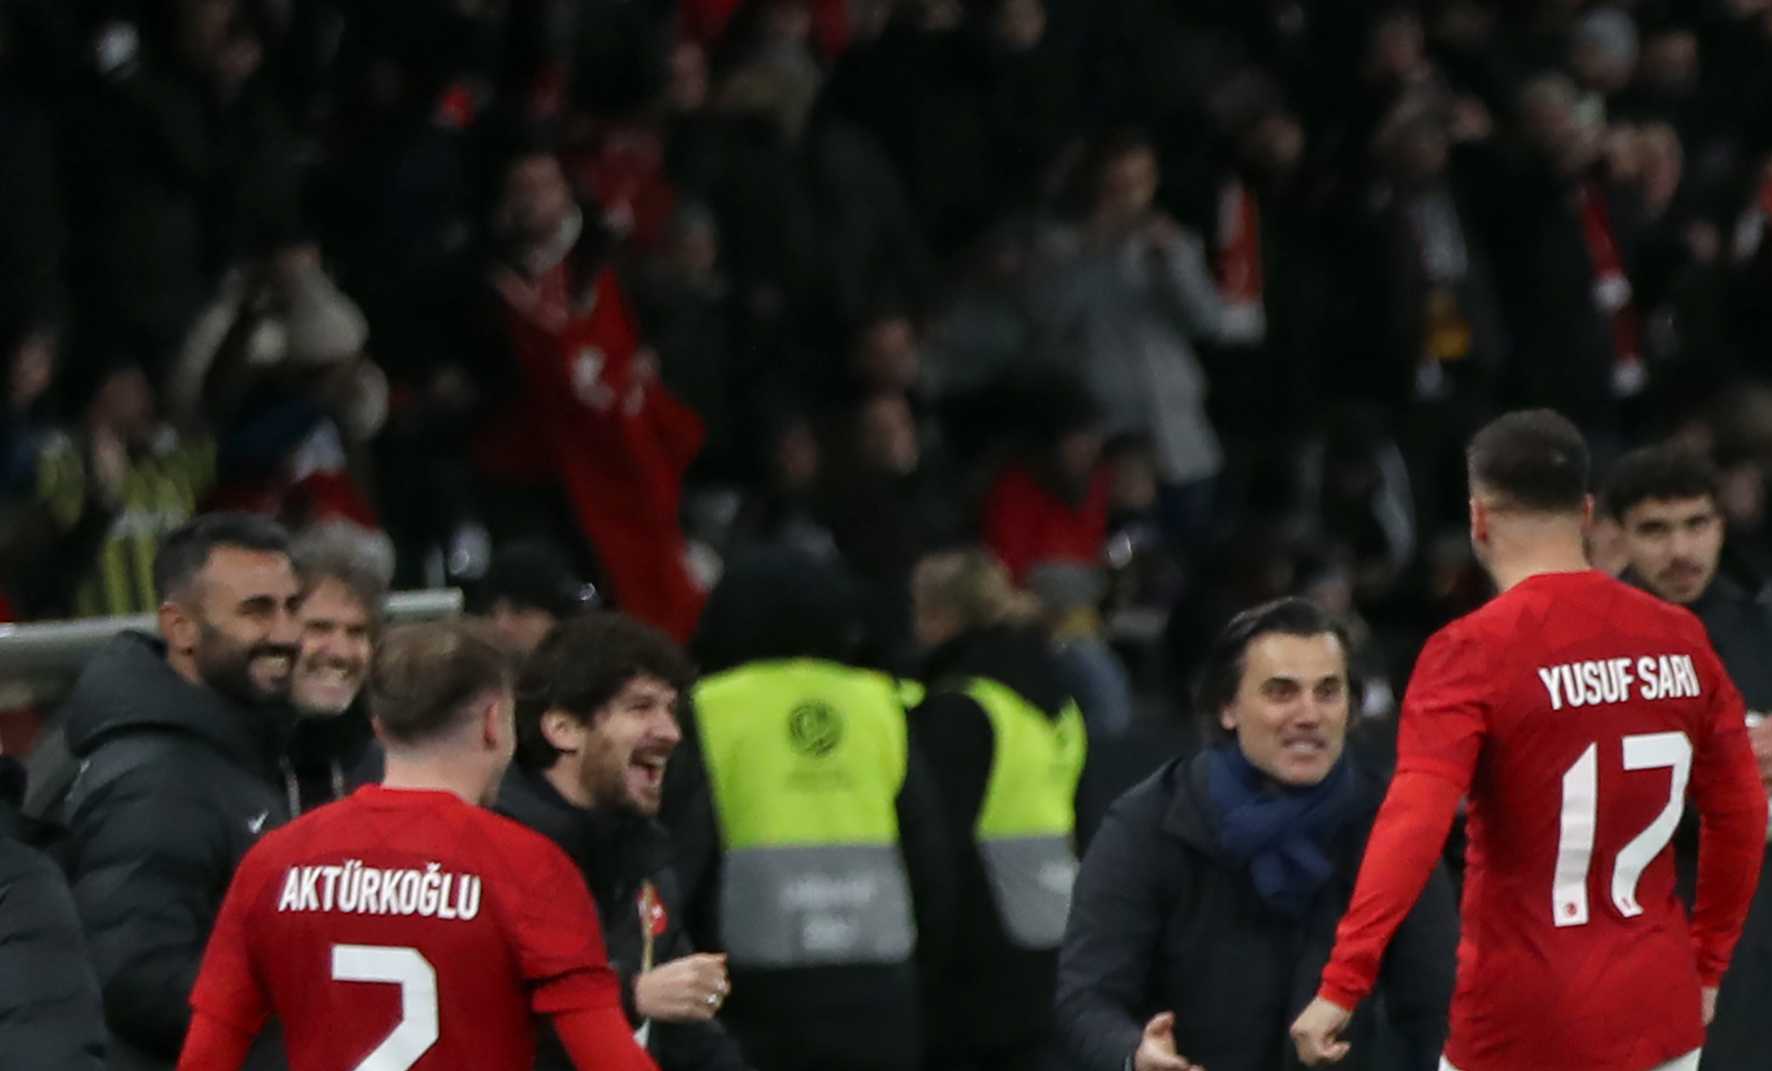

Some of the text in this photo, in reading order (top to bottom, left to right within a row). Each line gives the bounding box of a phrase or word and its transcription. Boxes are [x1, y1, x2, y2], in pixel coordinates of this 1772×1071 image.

[1538, 654, 1701, 710] YUSUF SARI
[1552, 731, 1693, 926] 17
[279, 859, 481, 921] AKTÜRKOĞLU
